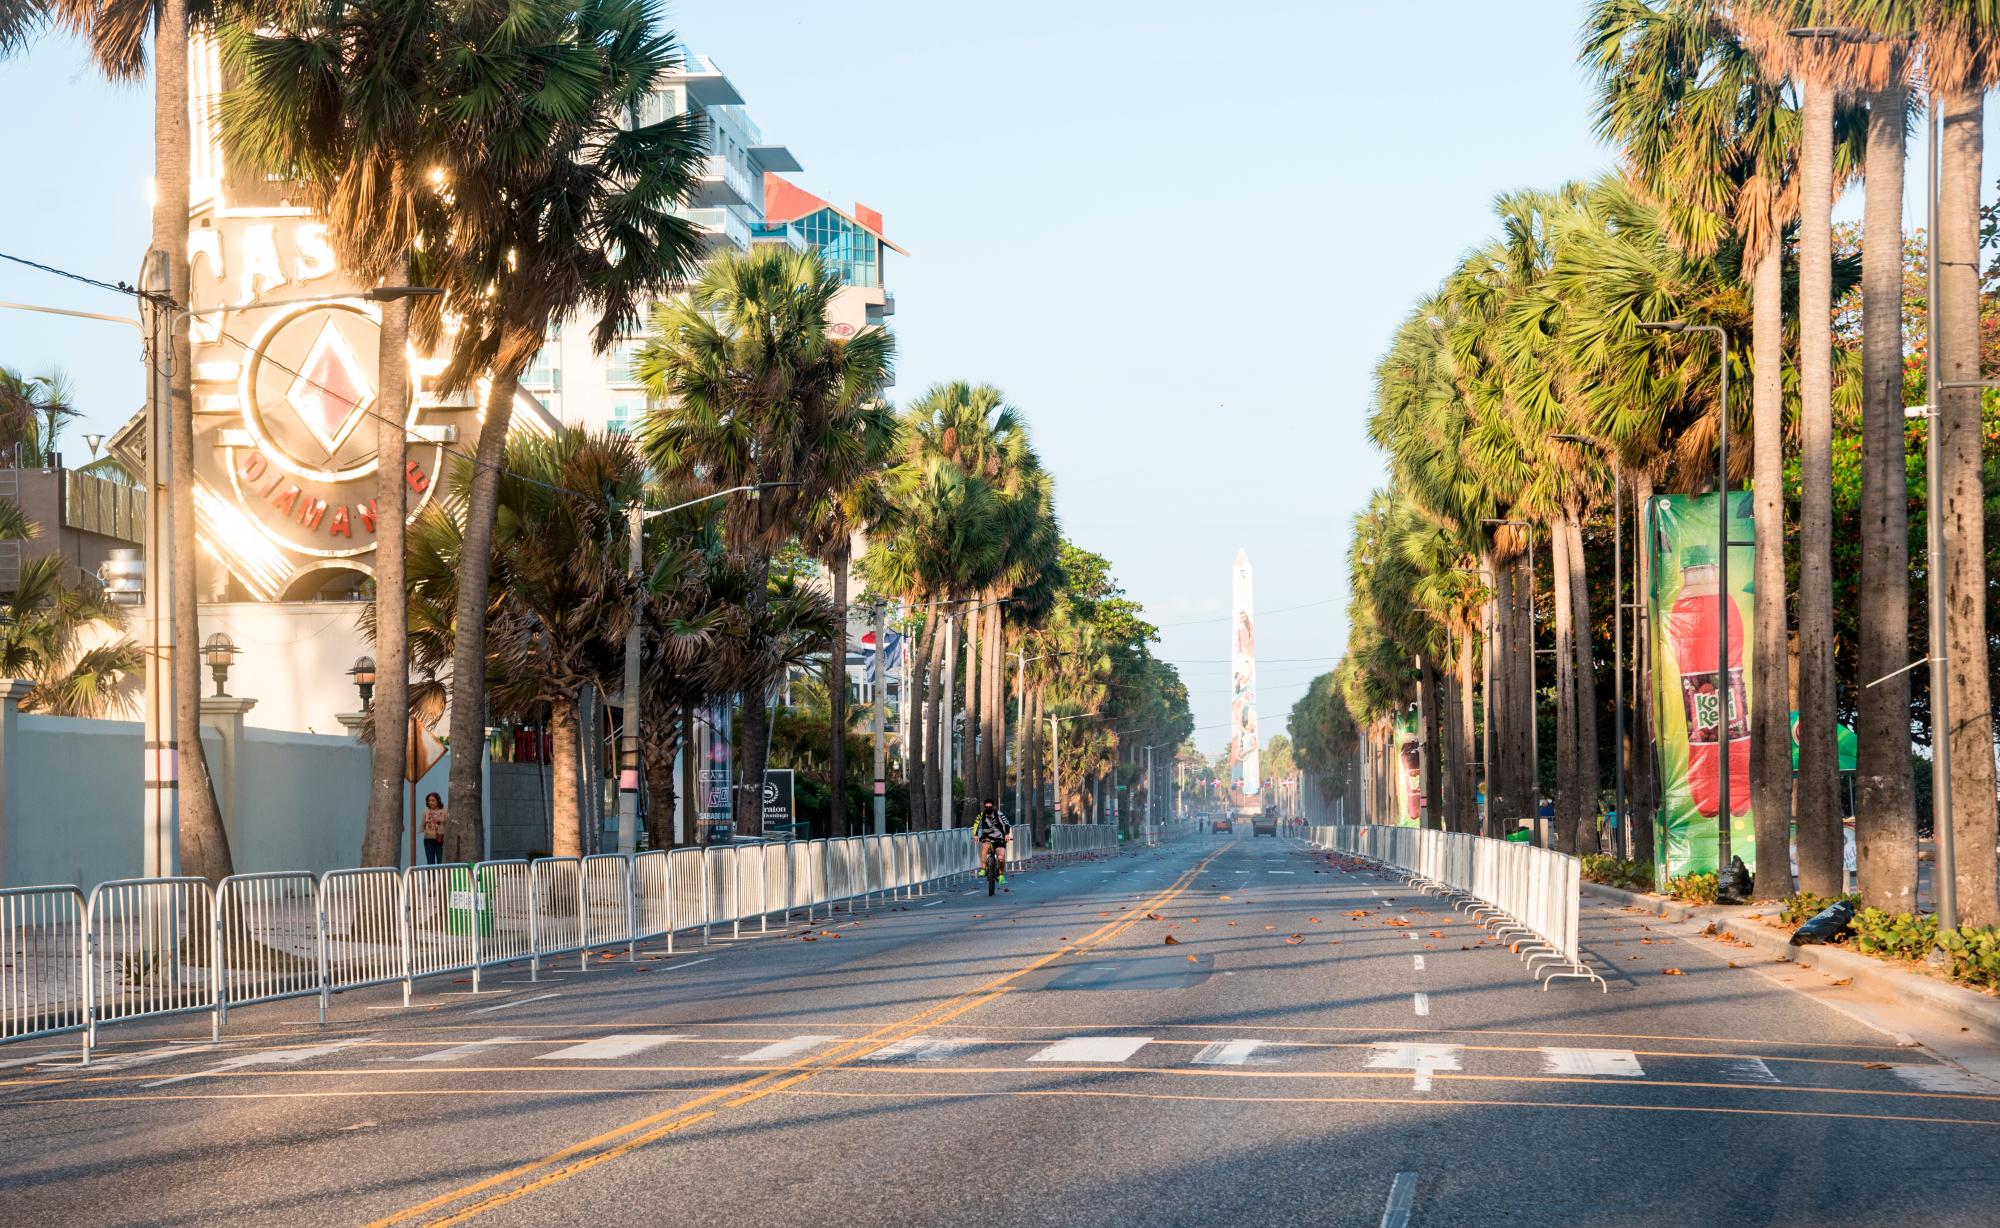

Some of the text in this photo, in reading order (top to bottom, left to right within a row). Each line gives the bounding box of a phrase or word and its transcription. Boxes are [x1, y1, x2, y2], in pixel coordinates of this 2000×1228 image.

[188, 223, 337, 346] CAS
[238, 452, 430, 538] DIAMANE
[1698, 702, 1735, 727] Rel
